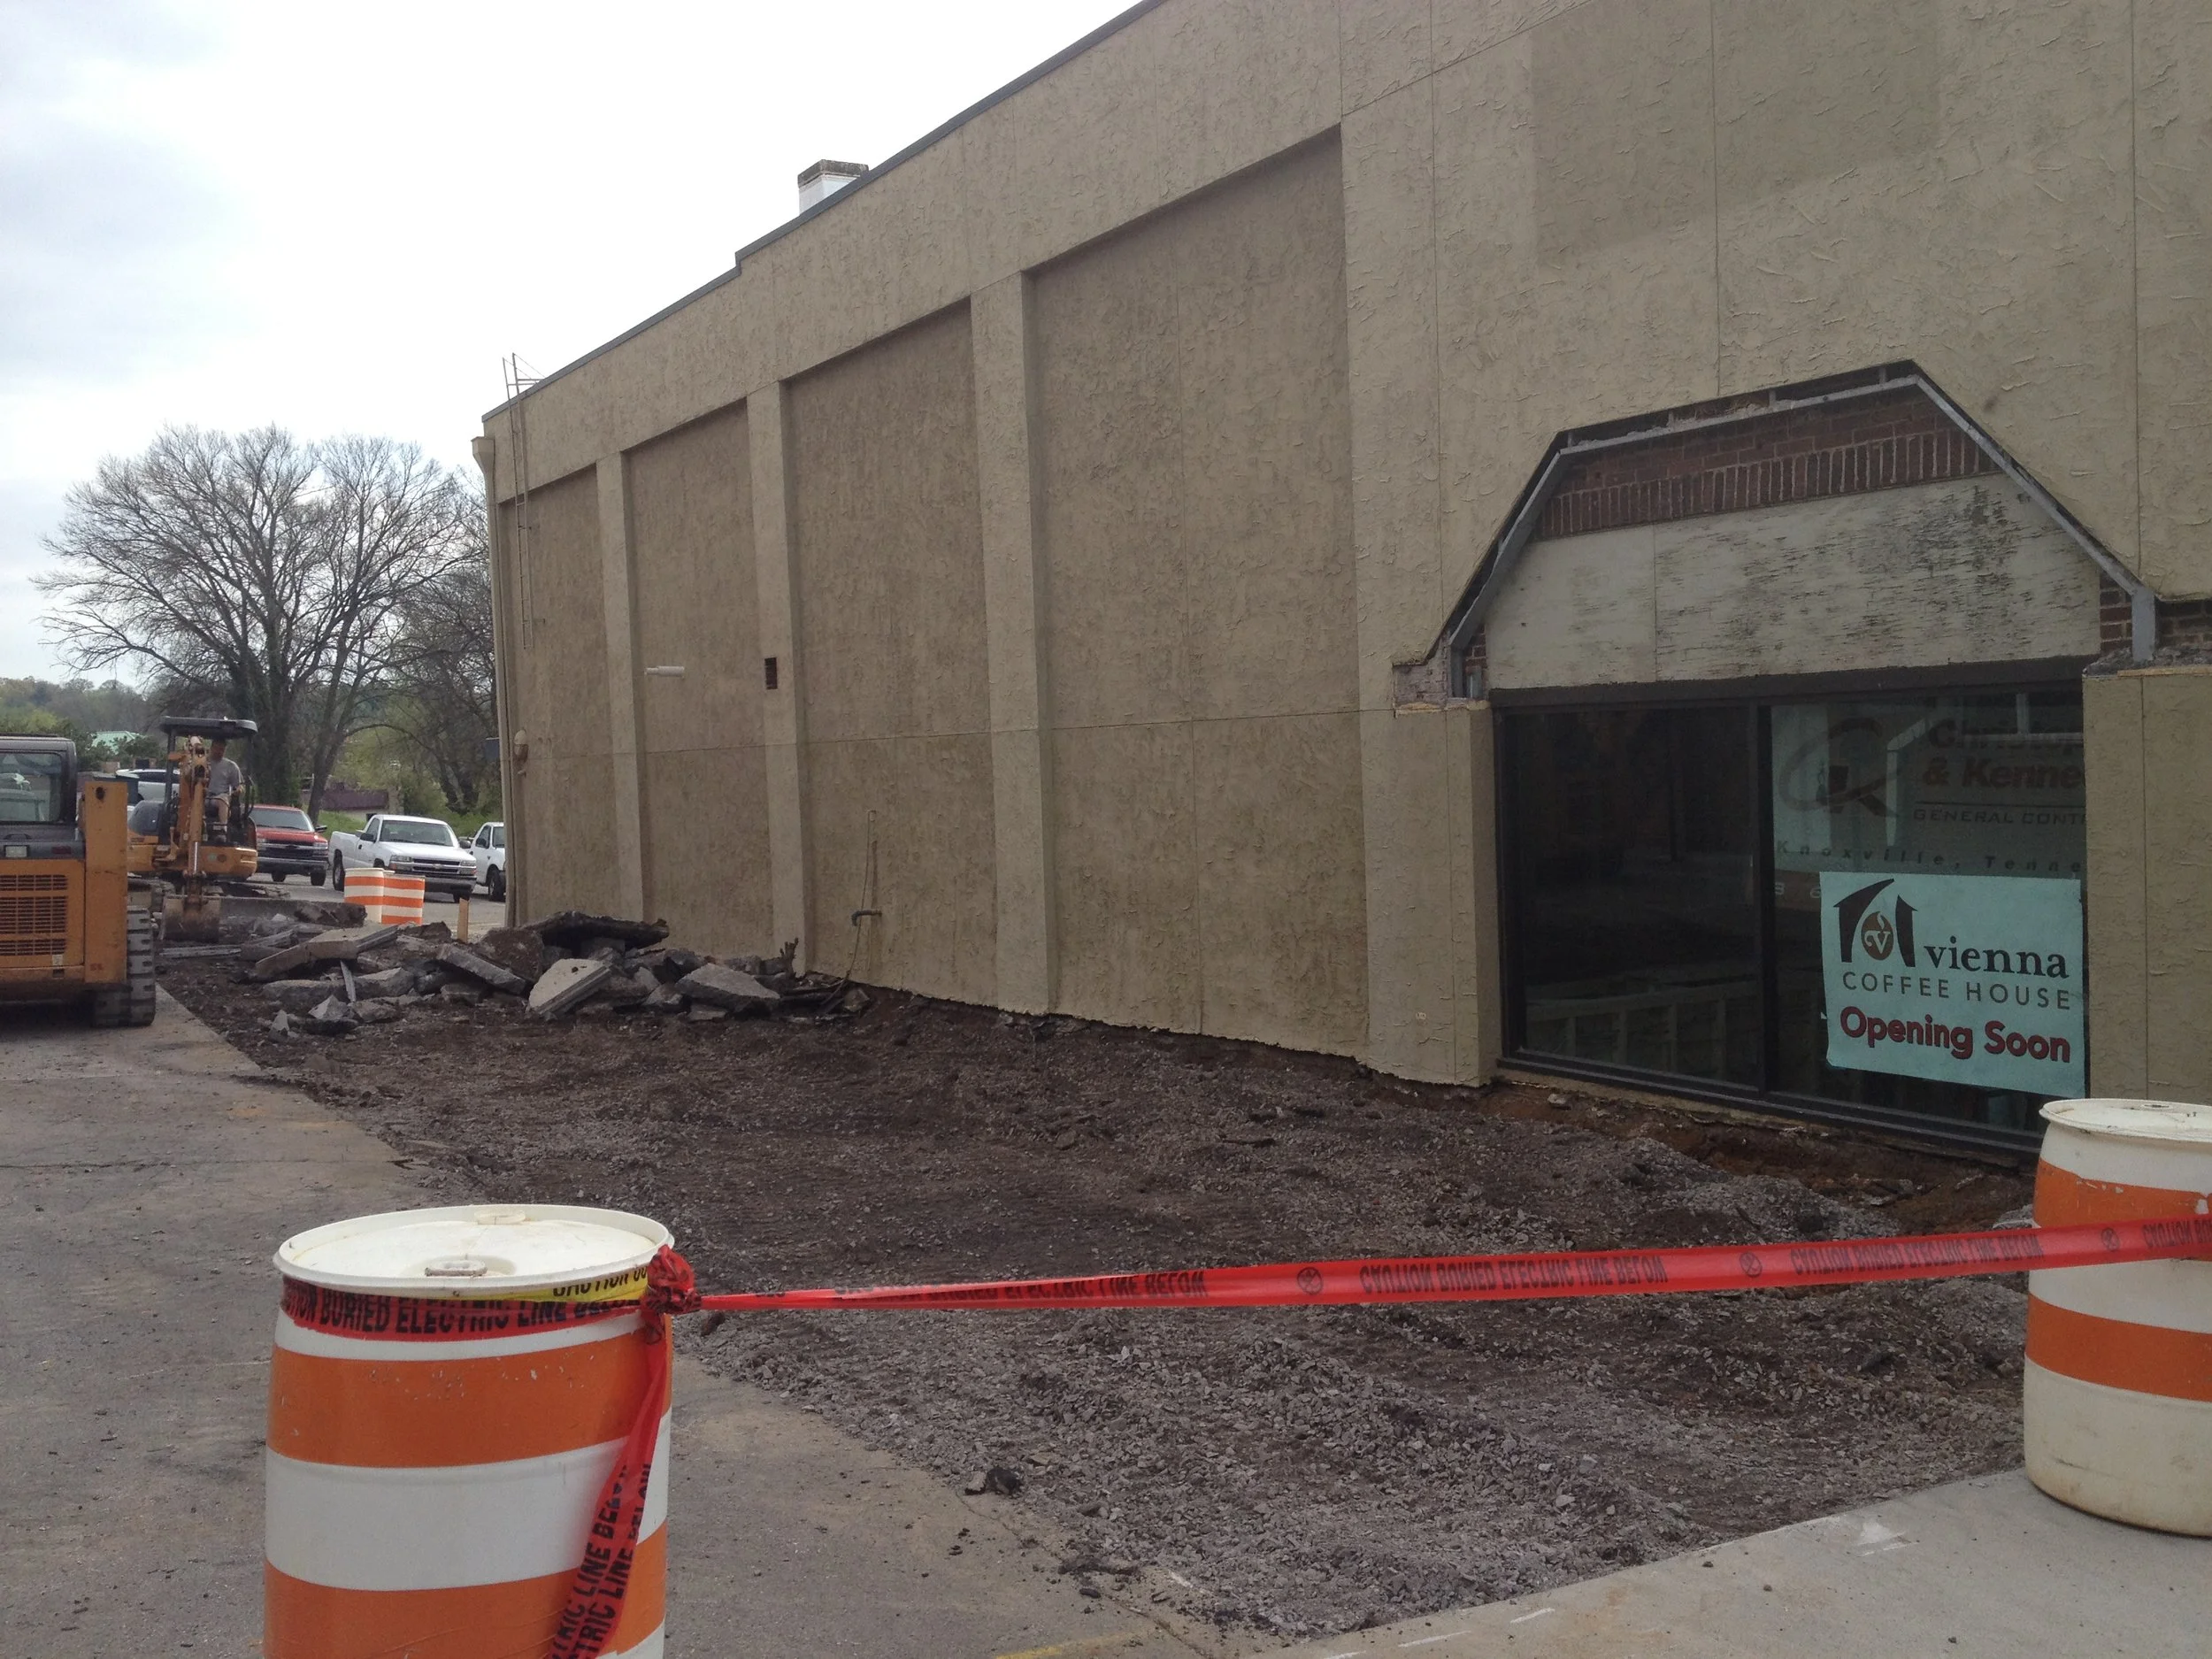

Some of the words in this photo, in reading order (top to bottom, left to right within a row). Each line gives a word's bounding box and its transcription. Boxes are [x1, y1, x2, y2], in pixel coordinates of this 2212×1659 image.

[1913, 808, 2014, 825] GENERAL
[1924, 935, 2070, 979] vienna
[1842, 971, 1949, 999] COFFEE
[1965, 981, 2070, 1010] HOUSE
[1839, 1006, 1974, 1060] Opening
[1983, 1020, 2071, 1064] Soon
[319, 1287, 391, 1333] BURIED
[573, 1542, 611, 1598] LINE
[598, 1548, 634, 1601] LINE
